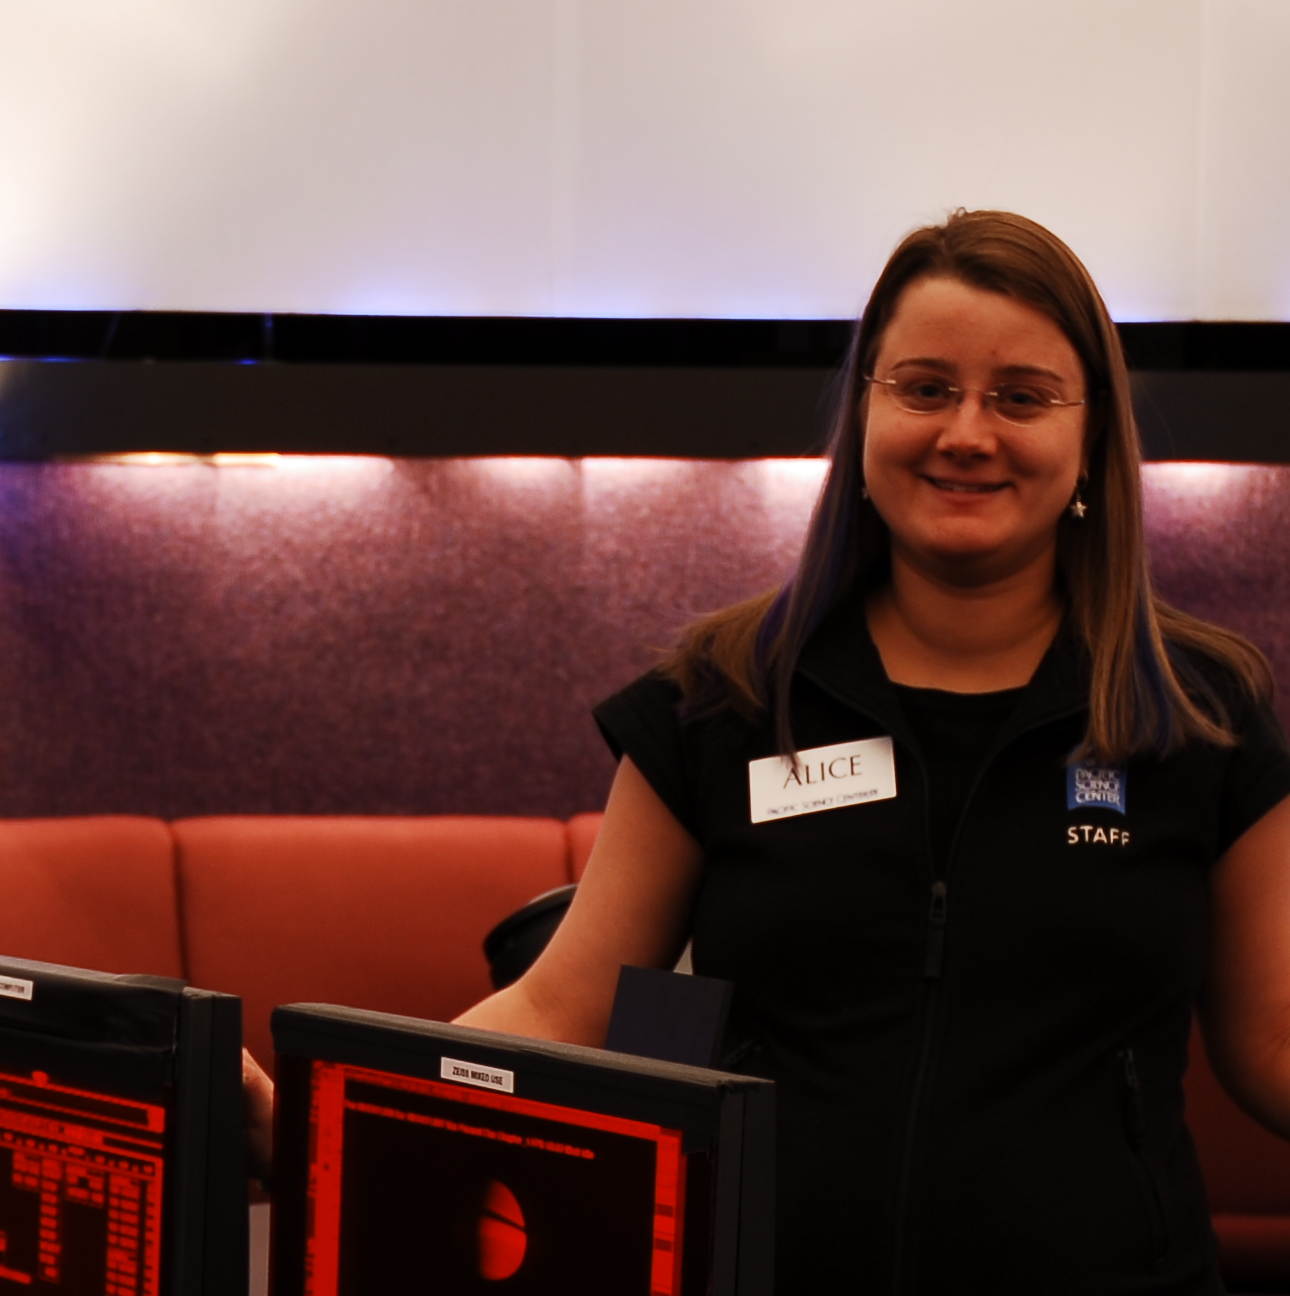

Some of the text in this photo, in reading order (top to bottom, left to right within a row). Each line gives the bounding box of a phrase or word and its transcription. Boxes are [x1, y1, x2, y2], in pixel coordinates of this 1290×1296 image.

[782, 754, 862, 789] ALICE
[1075, 791, 1121, 807] CENTER
[1067, 825, 1130, 846] STAFF
[490, 1074, 503, 1086] USE
